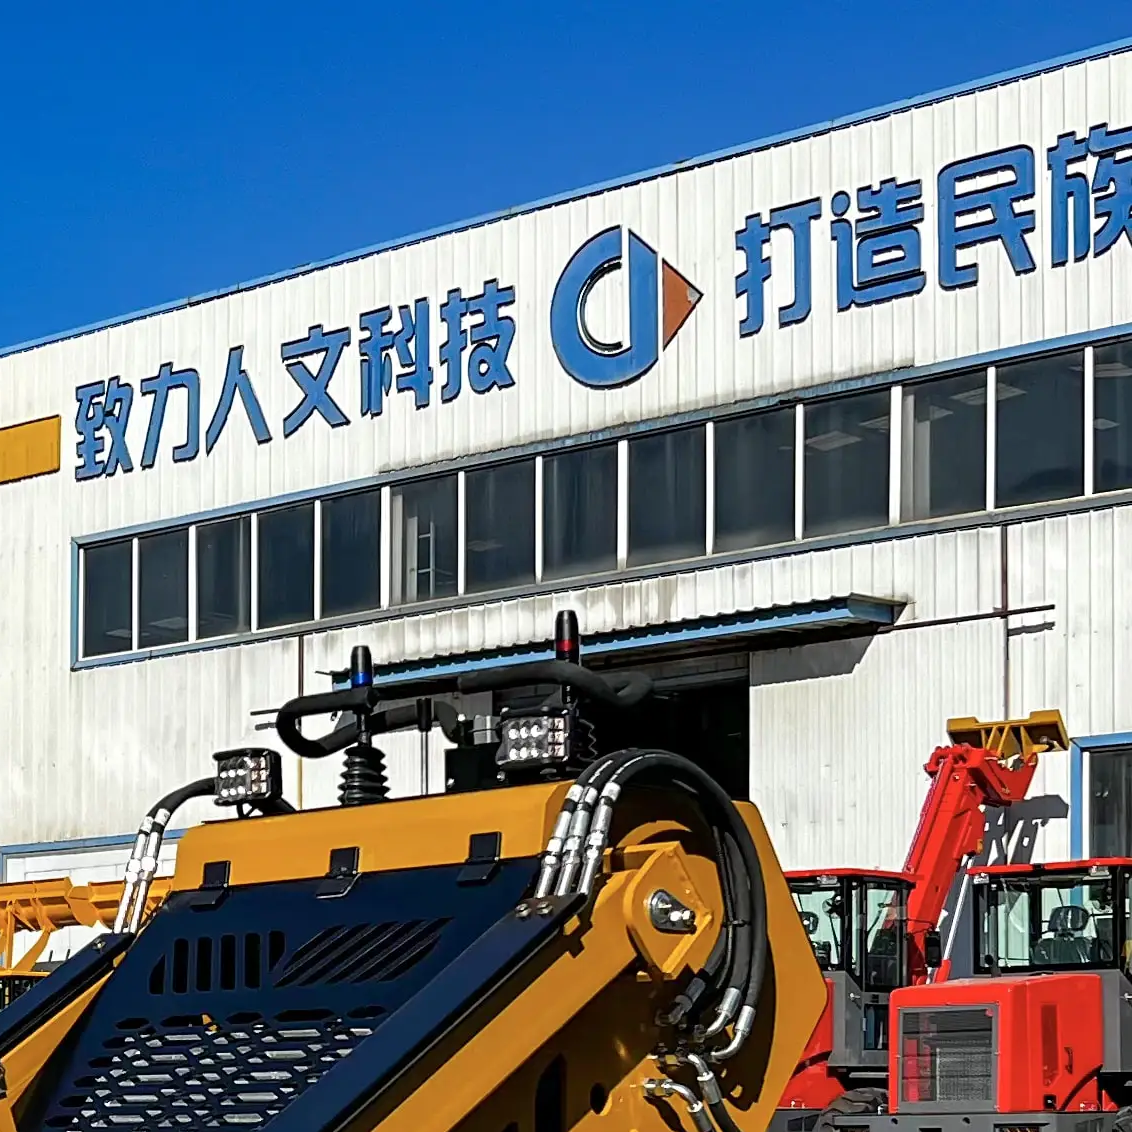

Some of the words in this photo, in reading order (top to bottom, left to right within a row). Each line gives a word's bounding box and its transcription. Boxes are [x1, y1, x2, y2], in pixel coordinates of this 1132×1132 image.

[75, 278, 516, 481] 致力人文科技
[735, 122, 1132, 338] 打造民族
